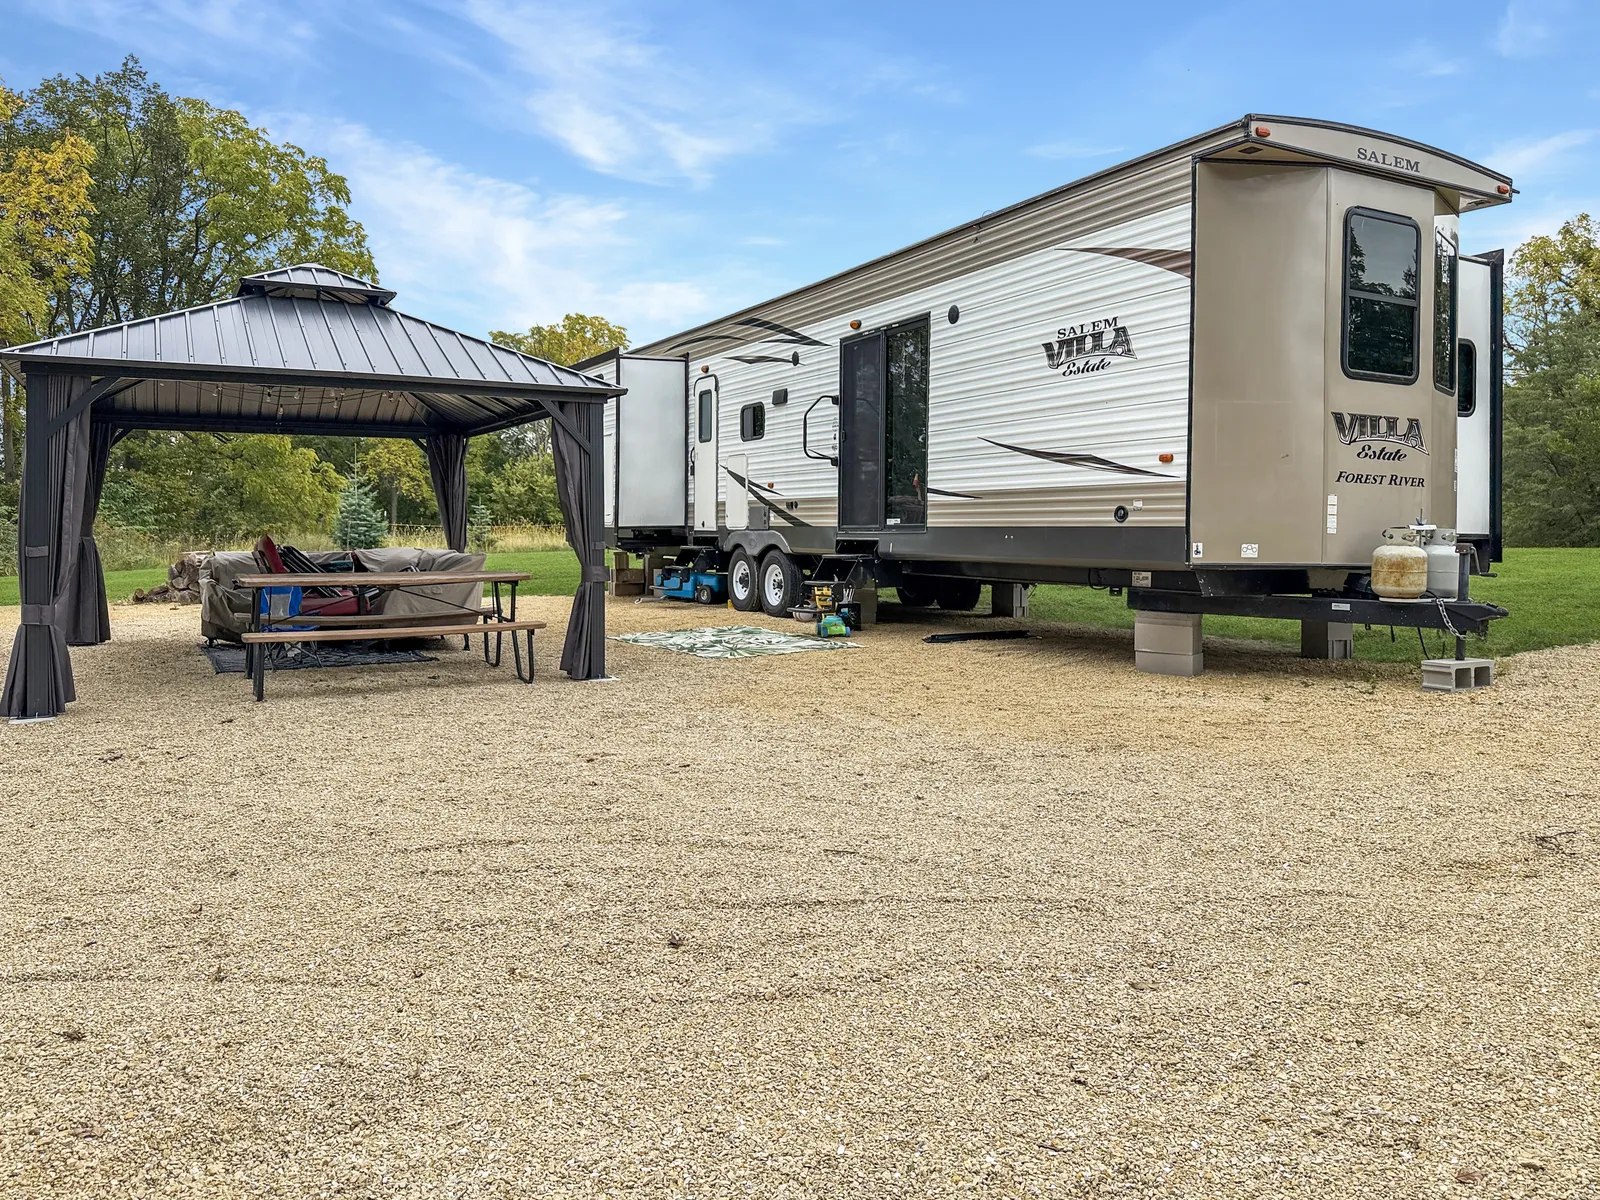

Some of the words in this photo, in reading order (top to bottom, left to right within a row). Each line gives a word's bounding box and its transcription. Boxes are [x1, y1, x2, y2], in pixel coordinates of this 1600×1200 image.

[1357, 147, 1420, 173] SALEM
[1057, 316, 1119, 339] SALEM
[1041, 326, 1138, 369] VILLA
[1062, 357, 1111, 377] Estate
[1330, 411, 1430, 456] VILLA
[1356, 444, 1407, 461] Estate
[1335, 470, 1387, 485] FOREST
[1388, 474, 1425, 487] RIVER
